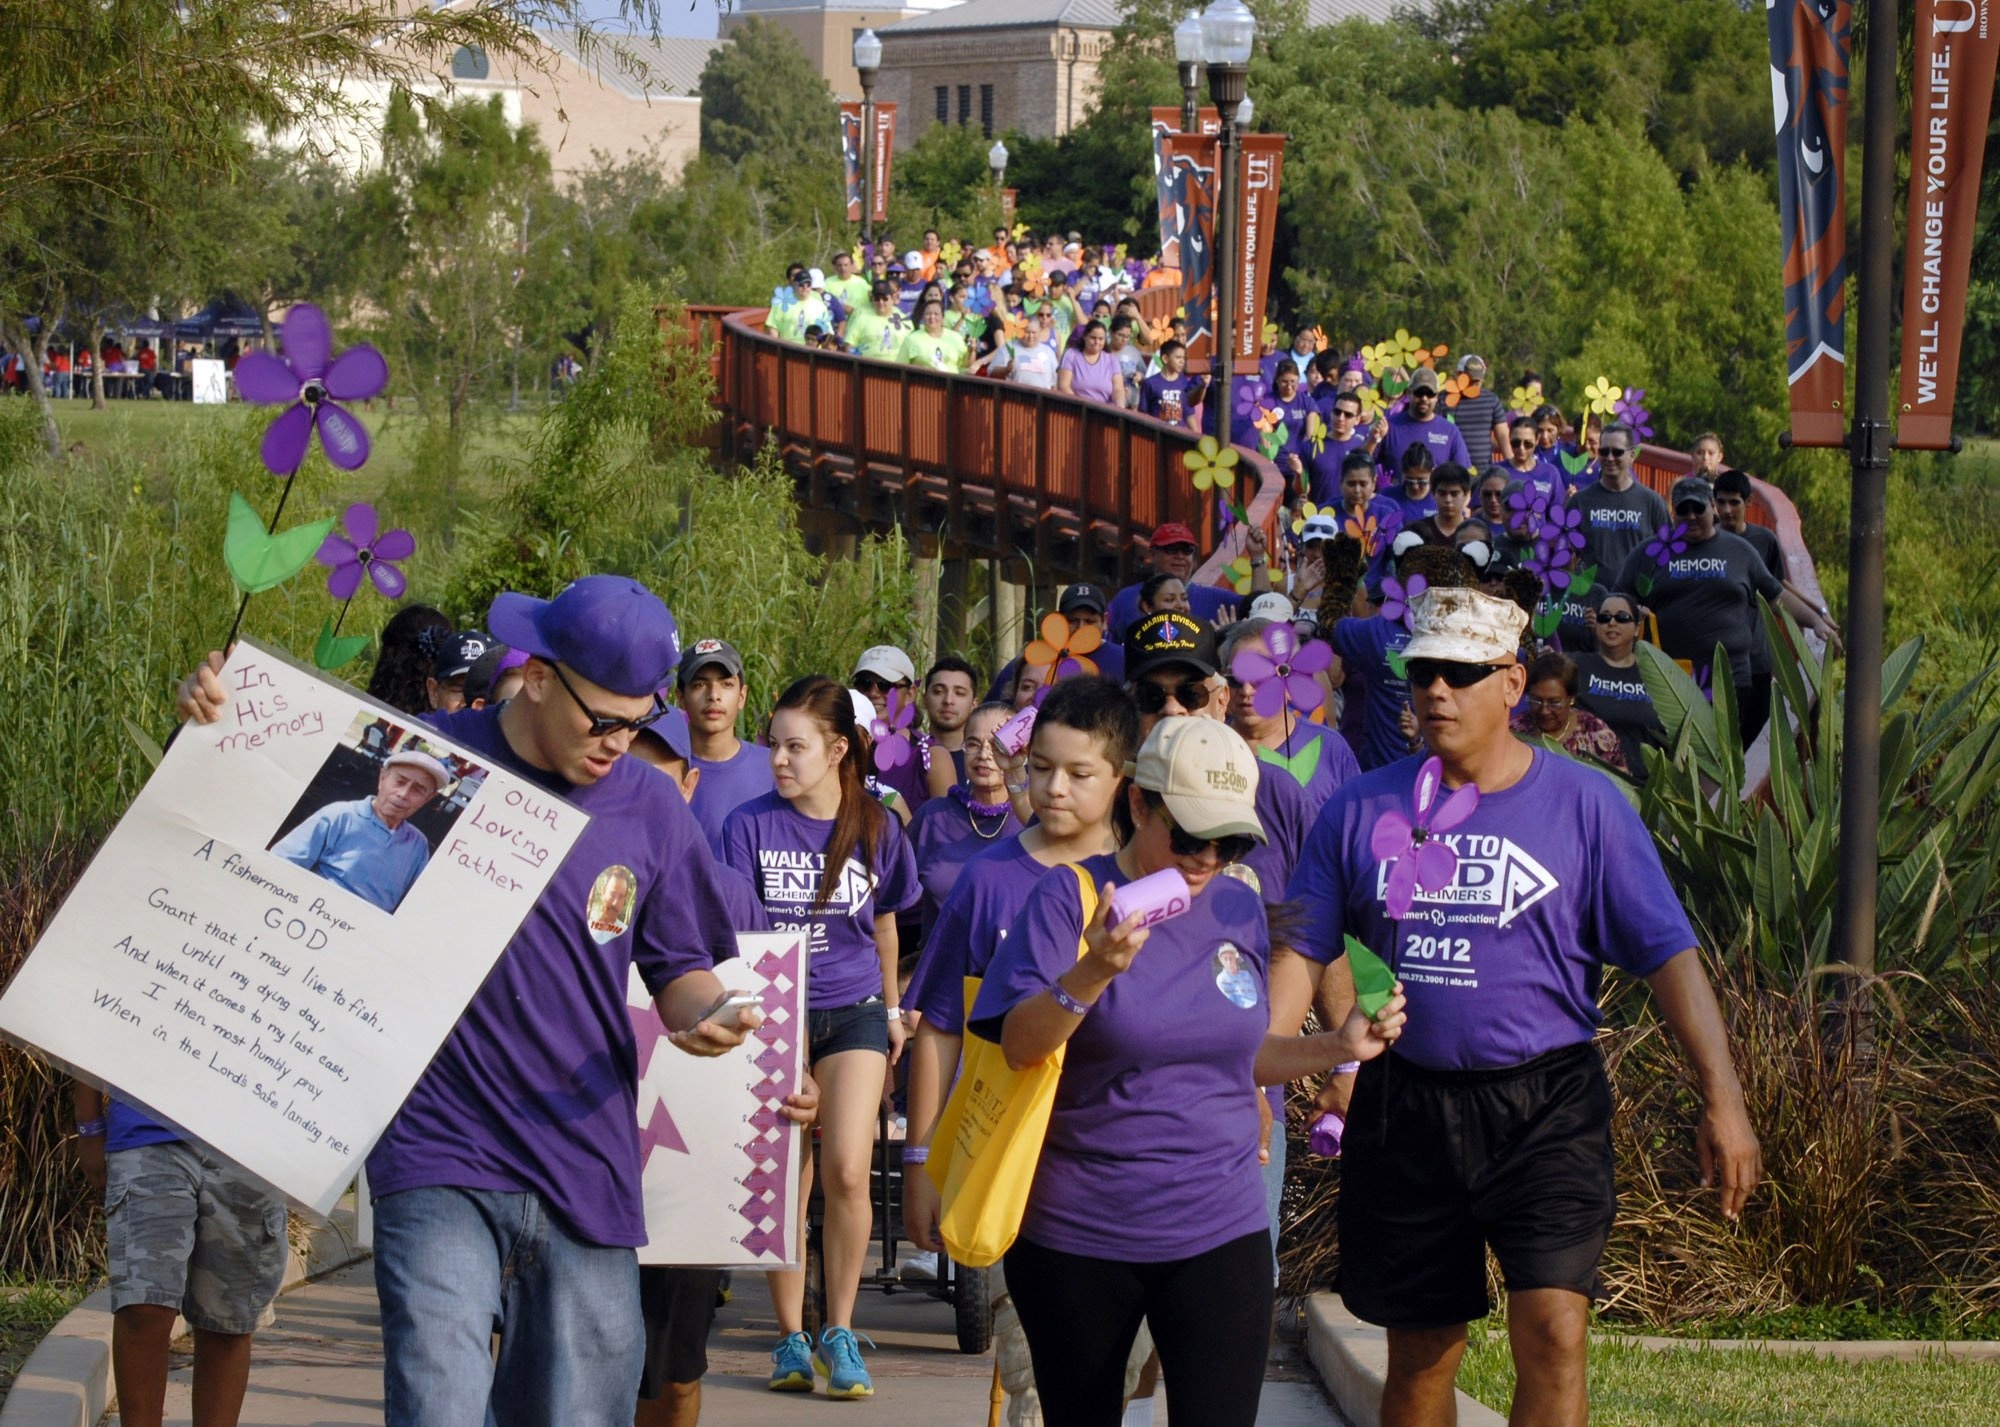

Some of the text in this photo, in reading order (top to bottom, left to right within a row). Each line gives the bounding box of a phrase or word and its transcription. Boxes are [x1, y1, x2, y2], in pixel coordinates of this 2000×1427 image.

[1247, 153, 1268, 190] UT
[1917, 45, 1950, 404] WE'LL CHANGE YOUR LIFE.
[1243, 192, 1257, 356] WE'LL CHANGE YOUR LIFE.
[1590, 509, 1642, 522] MEMORY
[1669, 559, 1727, 572] MEMORY
[1142, 614, 1169, 632] MARINE
[1171, 614, 1200, 634] DIVISION
[234, 664, 276, 691] In
[1589, 673, 1646, 696] MEMOR
[236, 694, 289, 727] His
[1205, 769, 1248, 791] TESORO
[1226, 761, 1236, 771] EL
[470, 803, 549, 868] Loving
[1466, 834, 1500, 857] TO
[448, 838, 523, 892] Father
[758, 849, 828, 869] WALK T
[194, 839, 355, 933] A fishermans Prayer
[264, 907, 328, 950] GOD
[1447, 911, 1498, 925] association
[147, 887, 198, 926] Grant
[204, 921, 237, 946] that
[259, 951, 292, 977] may
[302, 966, 327, 995] live
[333, 988, 346, 1007] to
[1405, 934, 1471, 962] 2012
[113, 935, 150, 964] And
[155, 959, 189, 985] when
[193, 977, 206, 991] it
[208, 988, 247, 1014] comes
[251, 1009, 263, 1024] to
[267, 1023, 286, 1043] my
[289, 1030, 314, 1056] last
[1449, 977, 1478, 989] alz.org
[230, 969, 250, 991] my
[256, 984, 291, 1012] dying
[299, 1008, 326, 1033] day,
[141, 981, 323, 1102] I then most humbly pray
[93, 988, 141, 1027] When
[152, 1024, 168, 1042] in
[179, 1036, 202, 1060] the
[282, 1100, 322, 1144] landing
[325, 1134, 350, 1156] net
